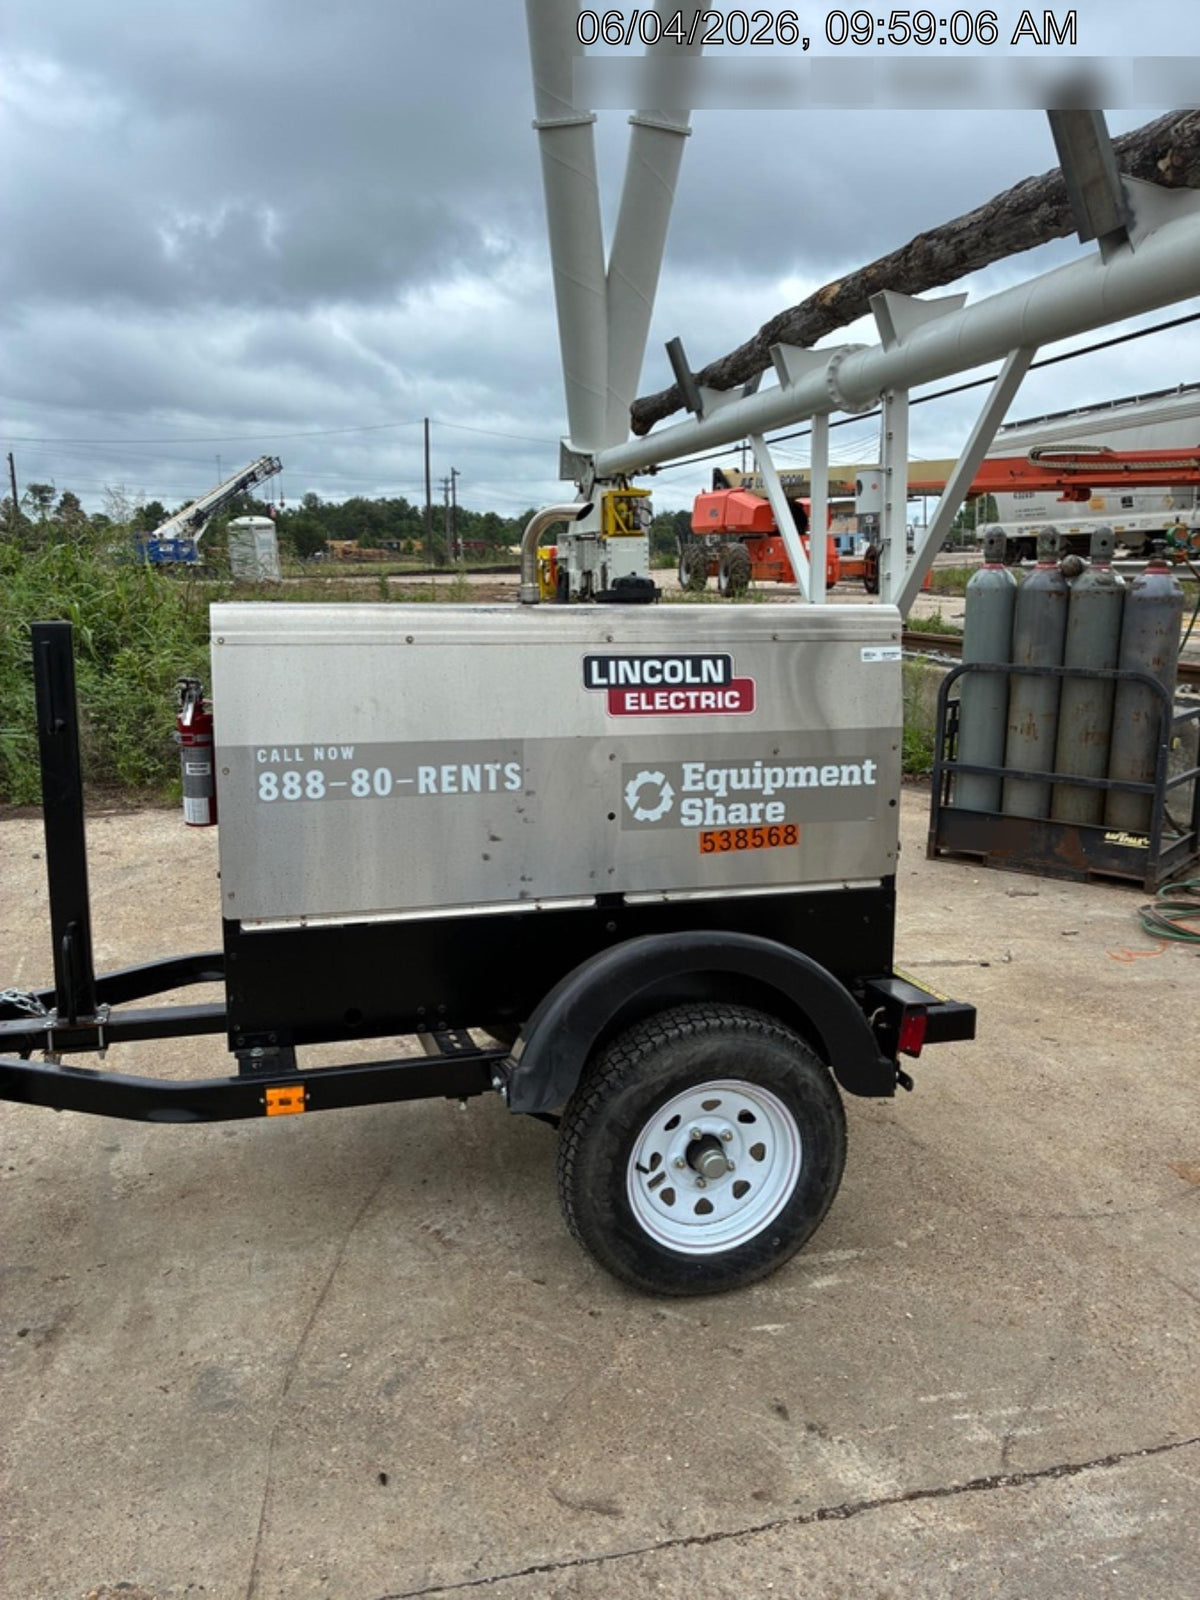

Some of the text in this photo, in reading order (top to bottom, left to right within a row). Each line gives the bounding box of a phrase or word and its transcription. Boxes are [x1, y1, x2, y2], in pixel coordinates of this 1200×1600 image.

[591, 659, 724, 685] LINCOLN
[624, 691, 740, 711] ELECTRIC
[257, 746, 355, 763] CALL NOW
[258, 763, 522, 801] 888-80-RENTS
[681, 759, 877, 797] Equipment
[680, 798, 785, 826] Share
[702, 824, 798, 853] 538568
